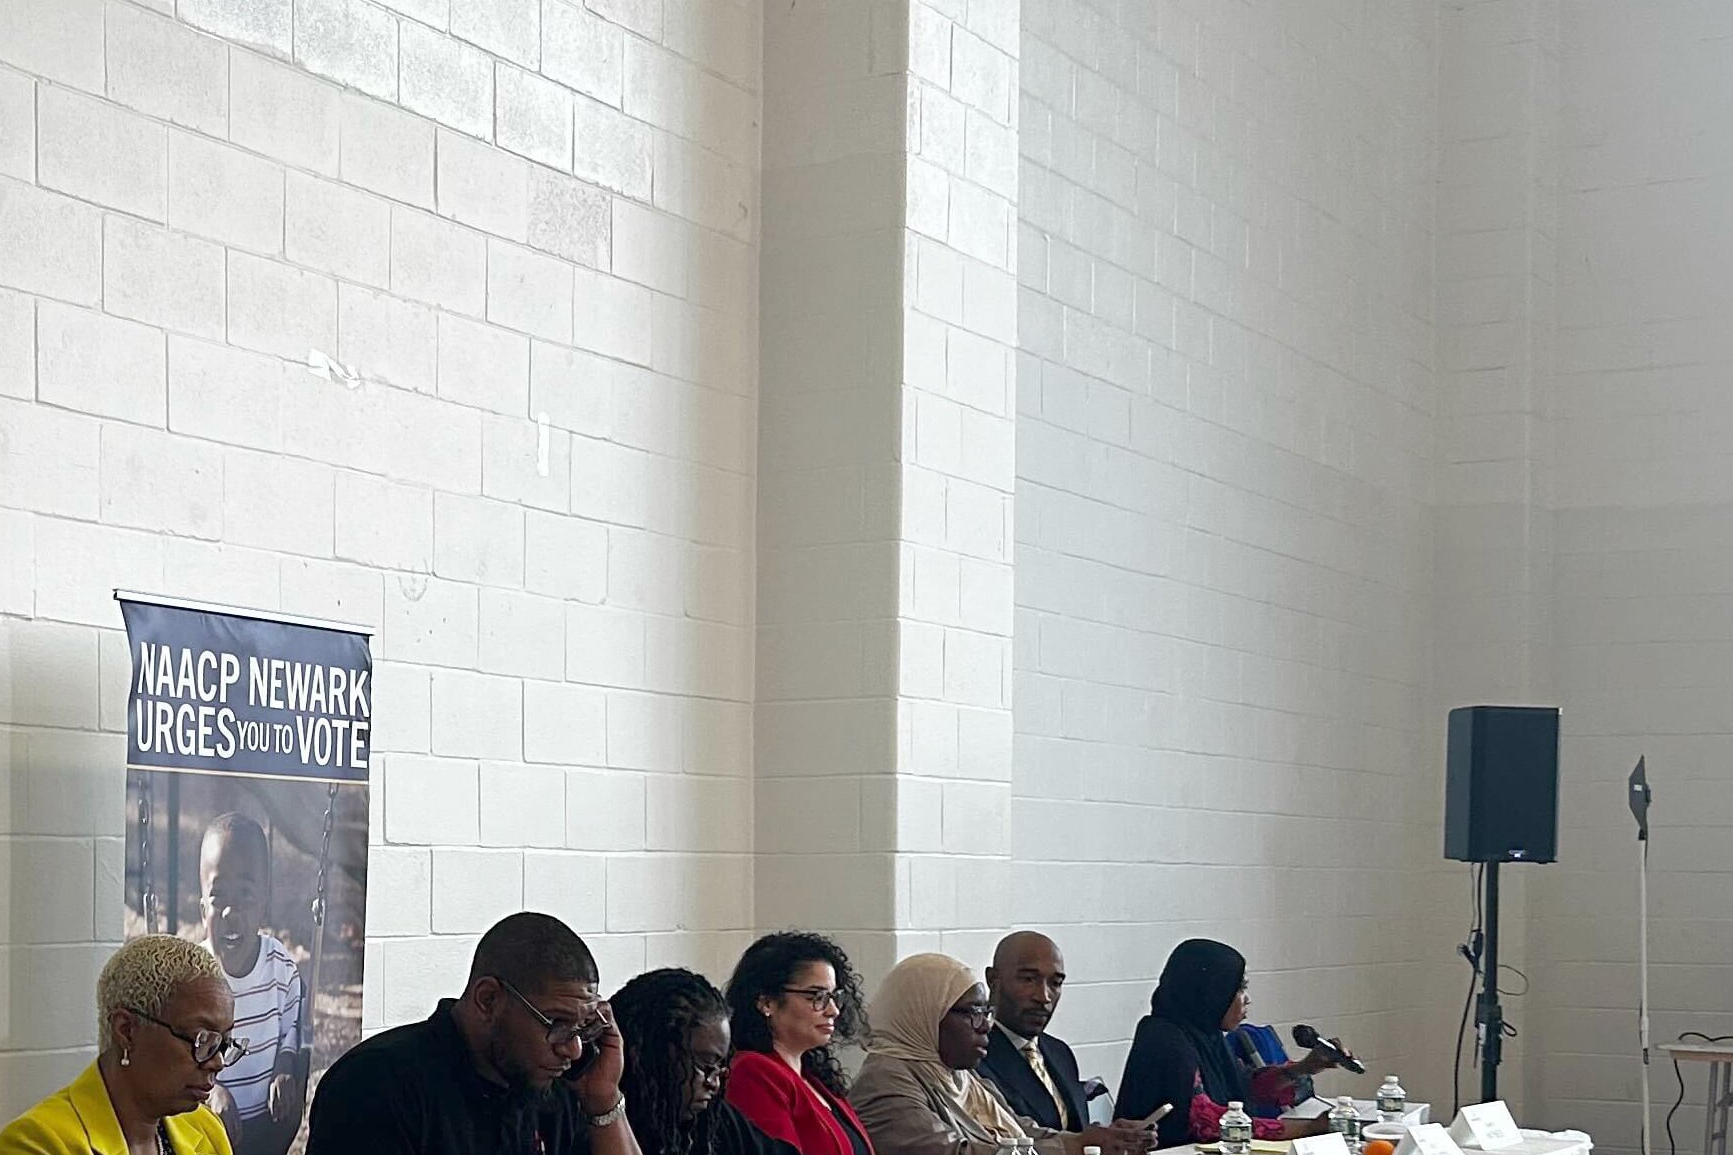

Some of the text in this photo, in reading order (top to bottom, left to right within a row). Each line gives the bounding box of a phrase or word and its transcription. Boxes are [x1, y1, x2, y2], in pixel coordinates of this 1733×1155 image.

[137, 641, 370, 718] NAACP NEWARK
[136, 698, 369, 769] URGES YOU TO VOTE
